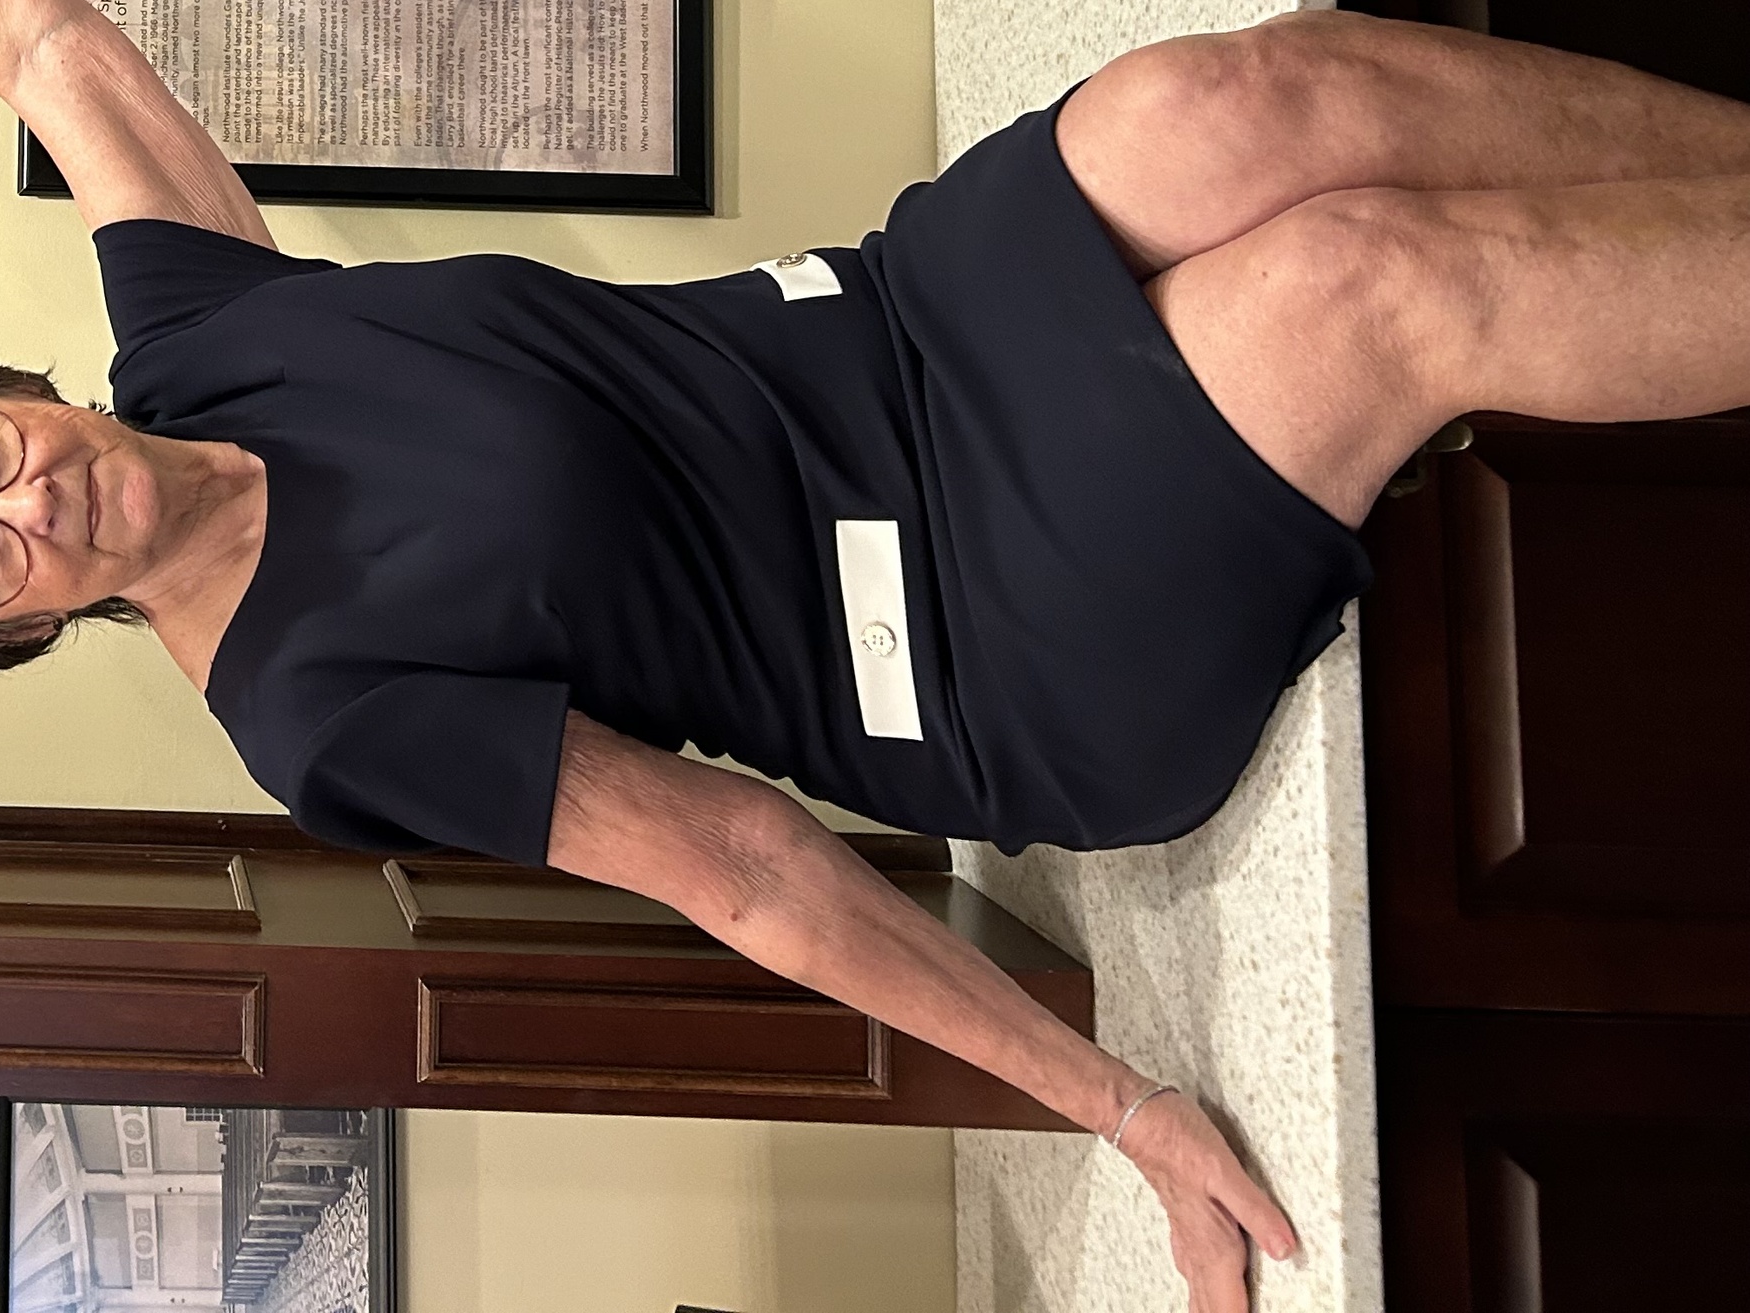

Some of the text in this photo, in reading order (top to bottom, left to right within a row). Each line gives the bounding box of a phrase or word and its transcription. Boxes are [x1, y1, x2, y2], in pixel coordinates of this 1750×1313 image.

[114, 0, 127, 16] of
[639, 3, 648, 21] that
[617, 28, 626, 49] West
[640, 24, 648, 39] out
[169, 36, 178, 66] named
[617, 52, 626, 66] the
[639, 41, 648, 71] moved
[619, 70, 626, 79] at
[617, 81, 627, 120] graduate
[639, 73, 648, 124] Northwood
[619, 122, 626, 132] to
[639, 126, 648, 153] When
